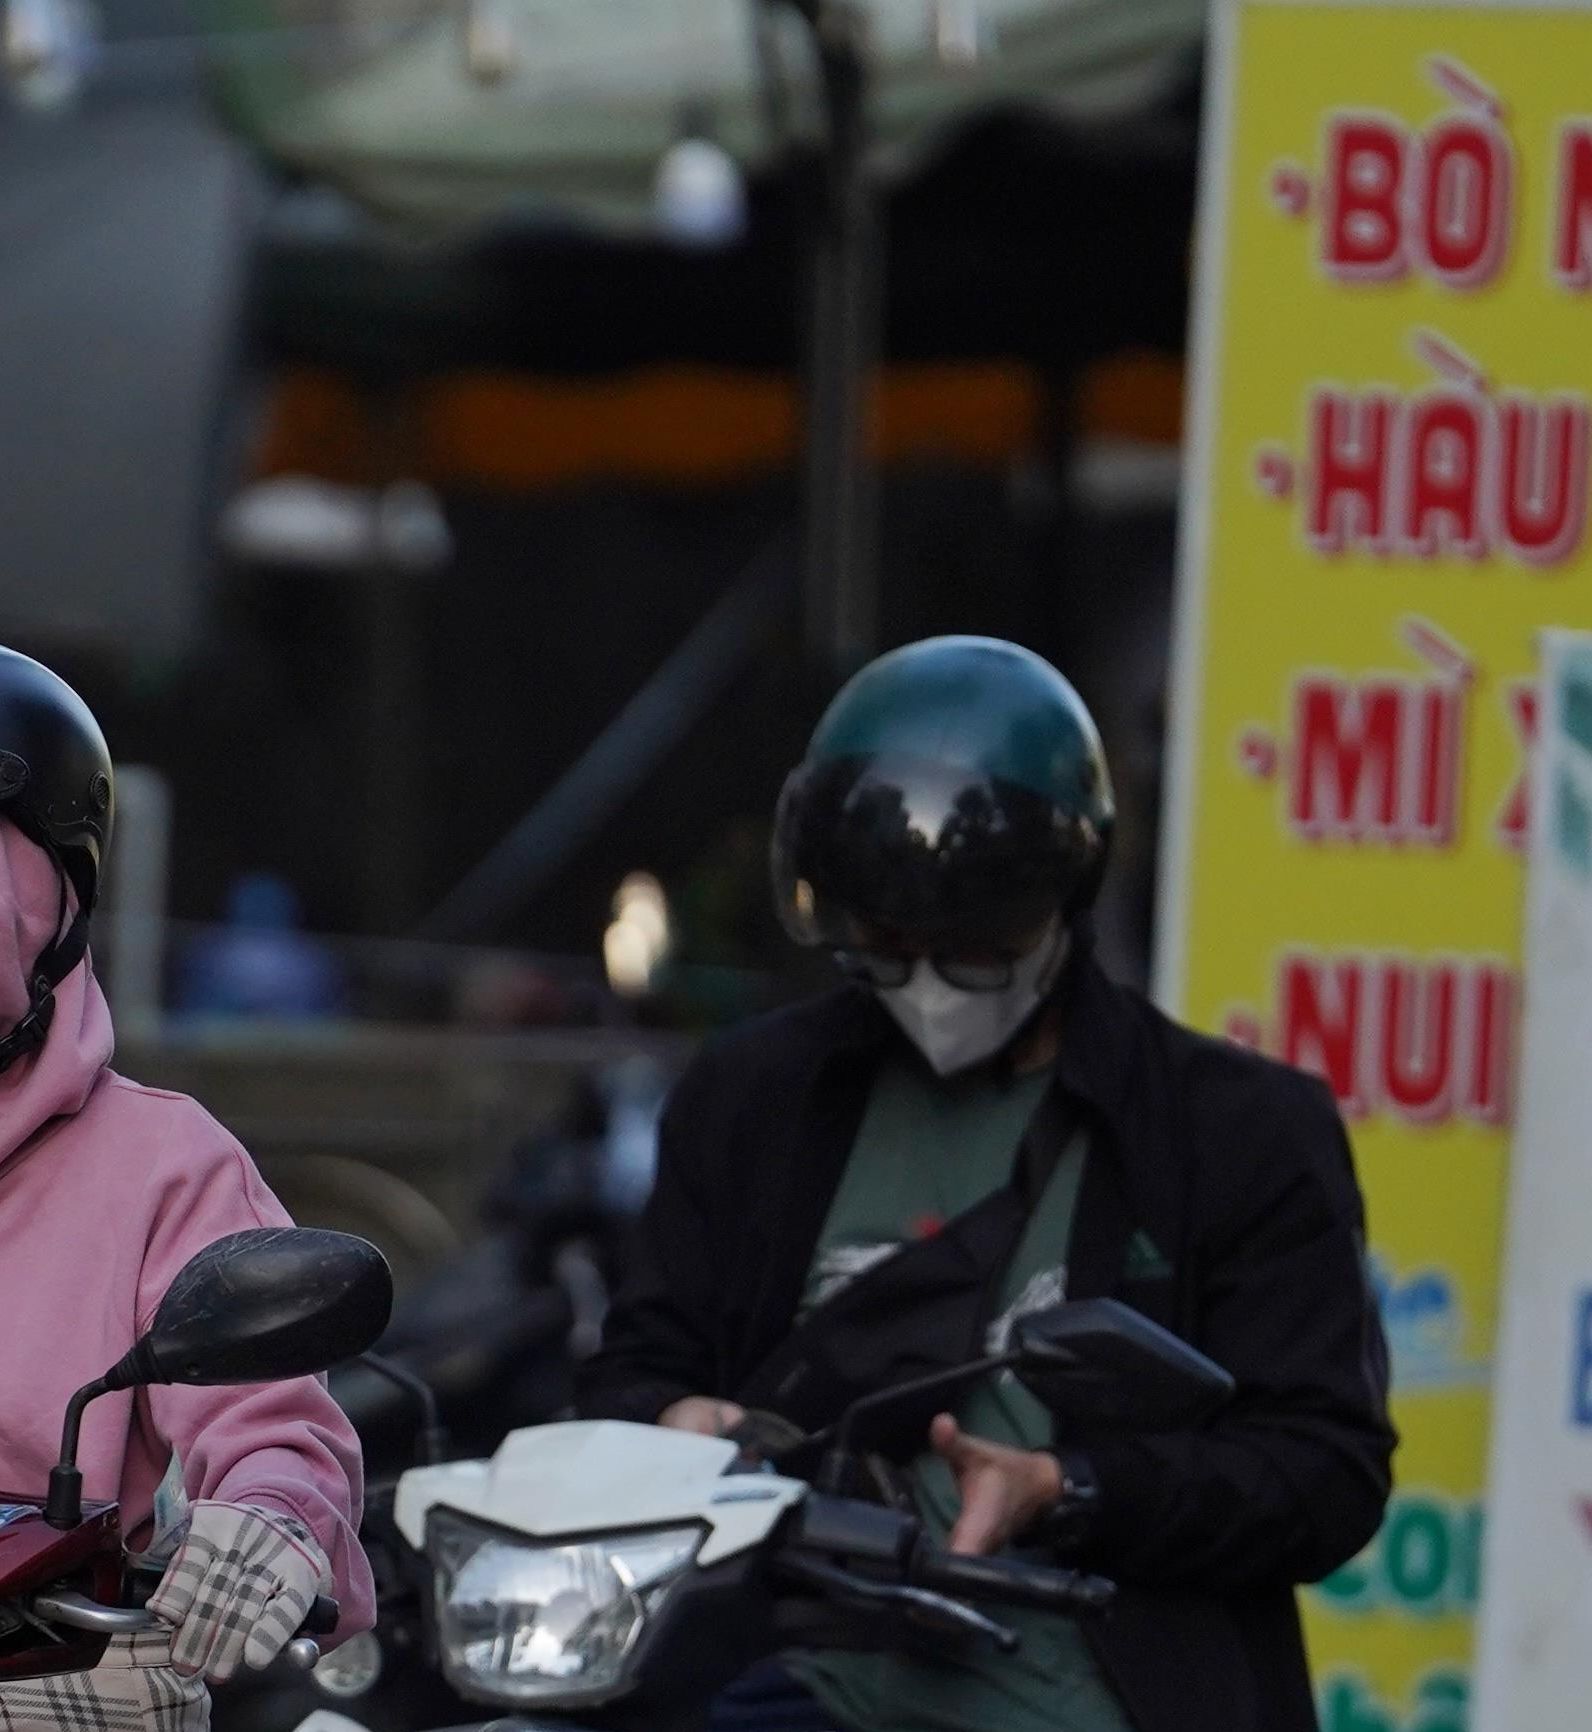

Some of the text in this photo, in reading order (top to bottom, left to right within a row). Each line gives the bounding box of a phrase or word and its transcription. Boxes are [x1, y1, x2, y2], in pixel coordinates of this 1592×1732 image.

[1321, 58, 1507, 280] BÒ
[1305, 332, 1585, 558] HÀU
[1287, 618, 1472, 840] MÌ
